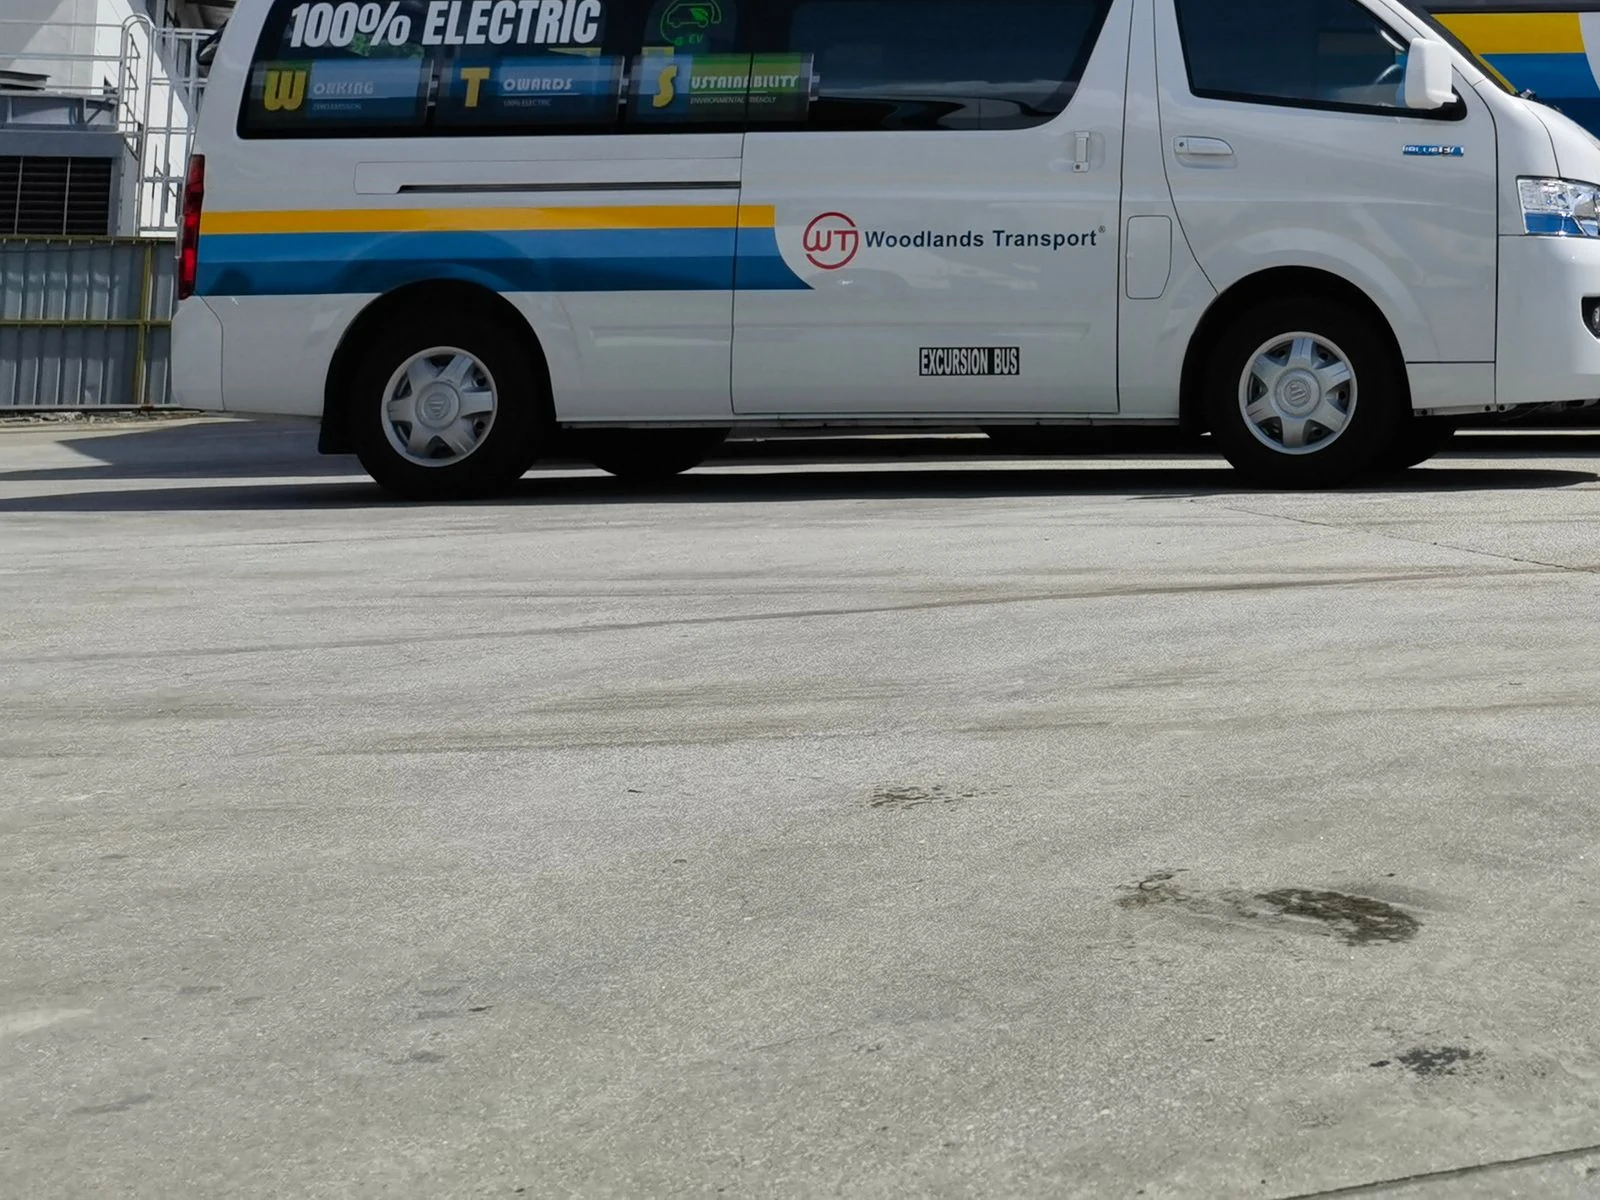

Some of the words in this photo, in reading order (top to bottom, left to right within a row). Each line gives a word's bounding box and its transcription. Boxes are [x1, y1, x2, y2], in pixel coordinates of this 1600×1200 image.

[291, 2, 411, 48] 100%
[422, 0, 601, 45] ELECTRIC
[865, 230, 983, 248] Woodlands
[921, 349, 989, 375] EXCURSION
[995, 348, 1018, 374] BUS
